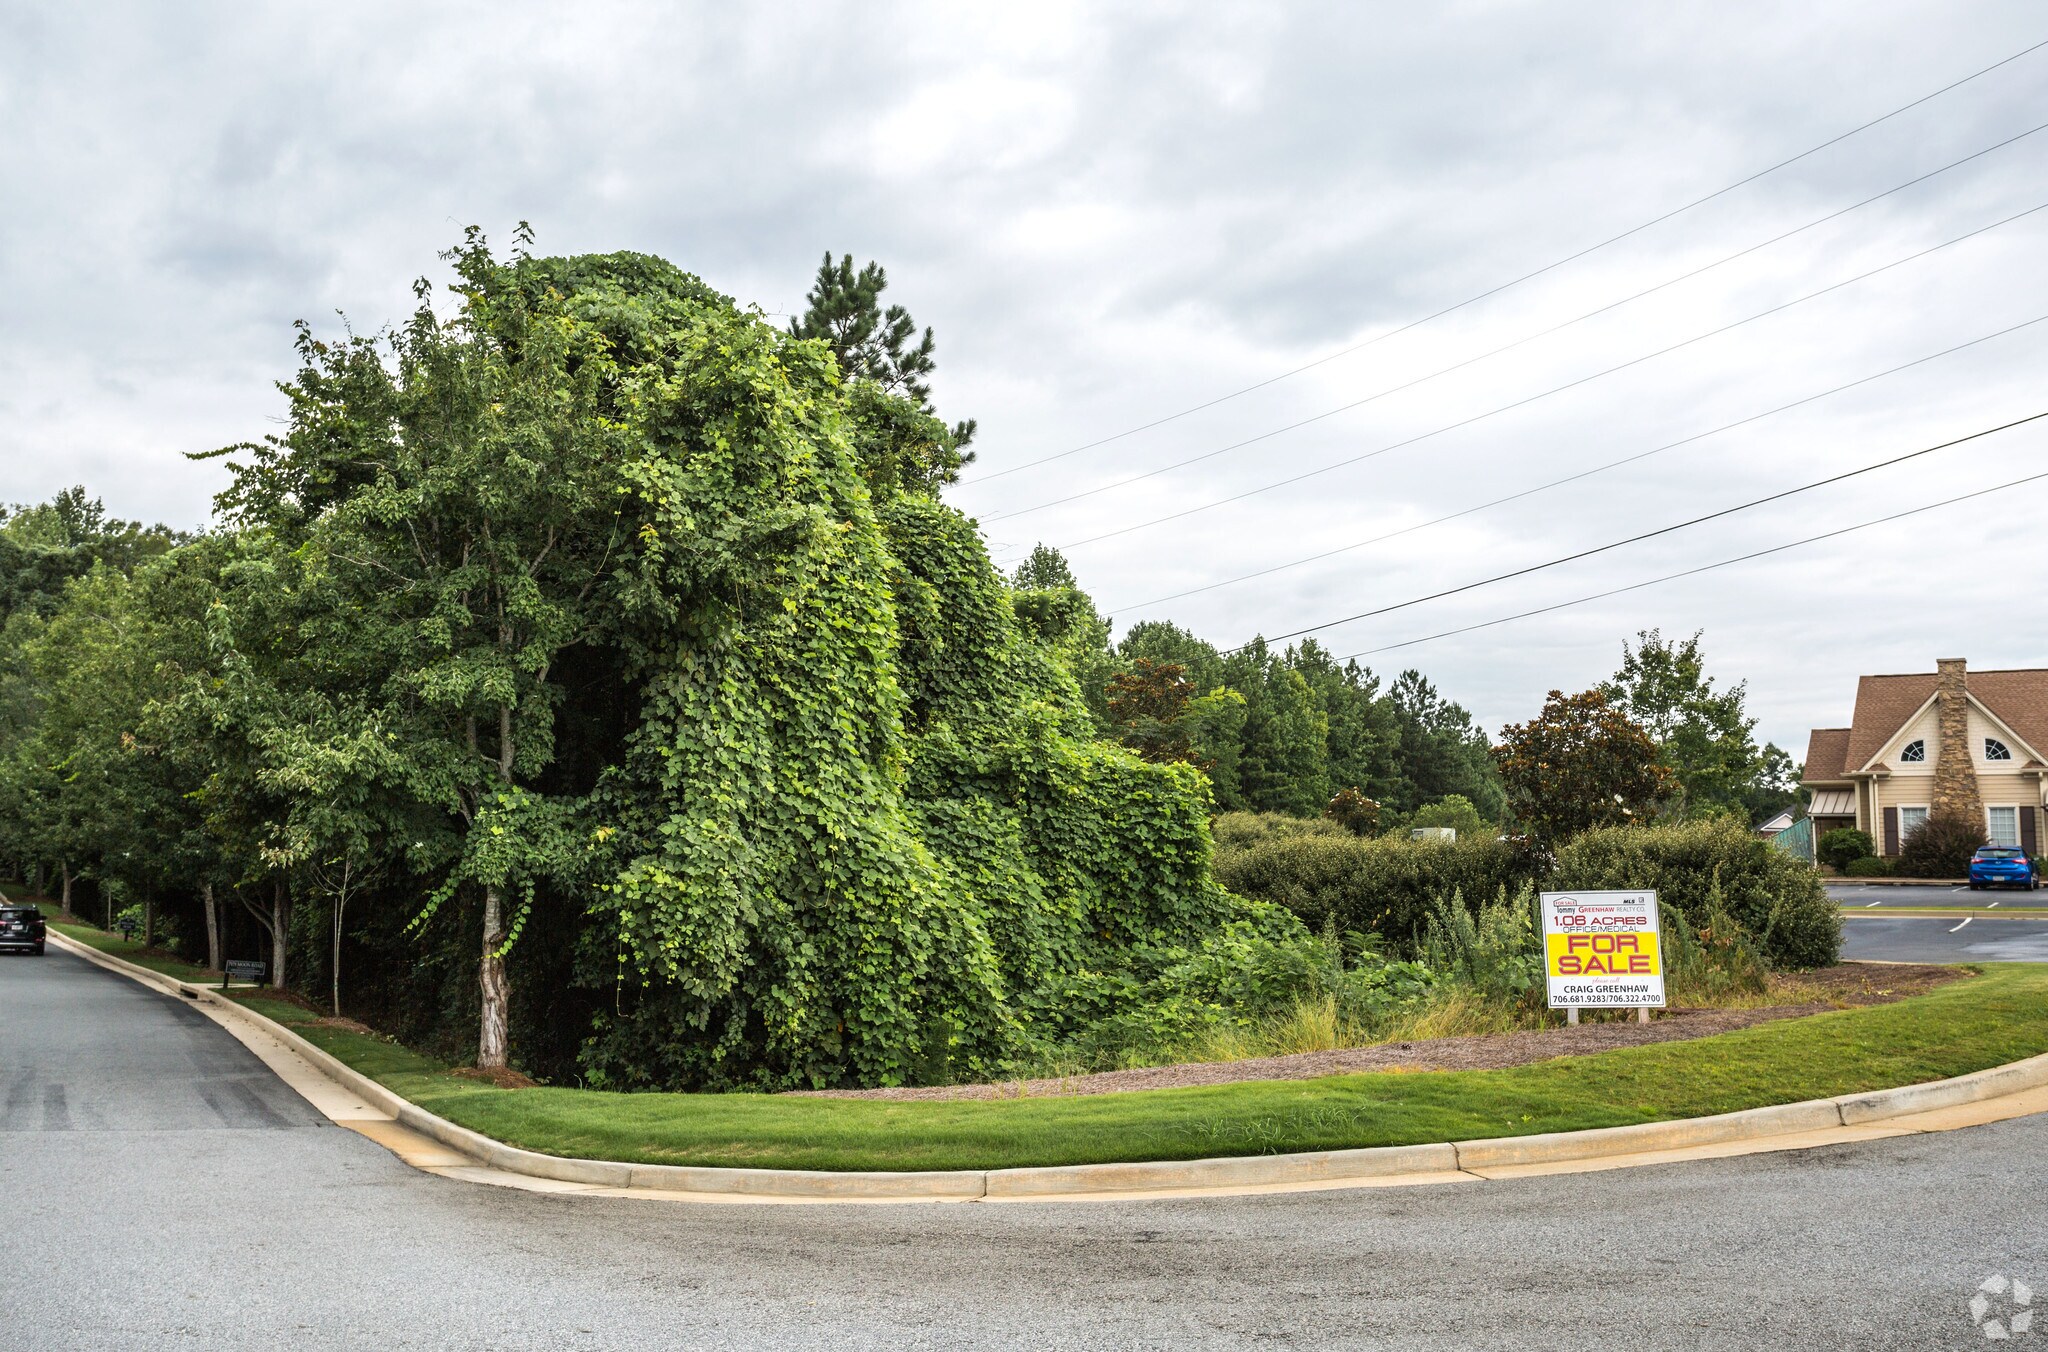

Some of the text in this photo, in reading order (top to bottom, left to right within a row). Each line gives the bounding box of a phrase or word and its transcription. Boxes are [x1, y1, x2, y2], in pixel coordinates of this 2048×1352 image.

[1556, 906, 1575, 914] Tommy
[1591, 916, 1647, 925] ACRES
[1567, 934, 1639, 954] FOR
[1558, 955, 1651, 975] SALE
[1563, 985, 1649, 993] CRAIG GREENHAW
[1553, 995, 1660, 1003] 706.681.9283/706.322.4700
